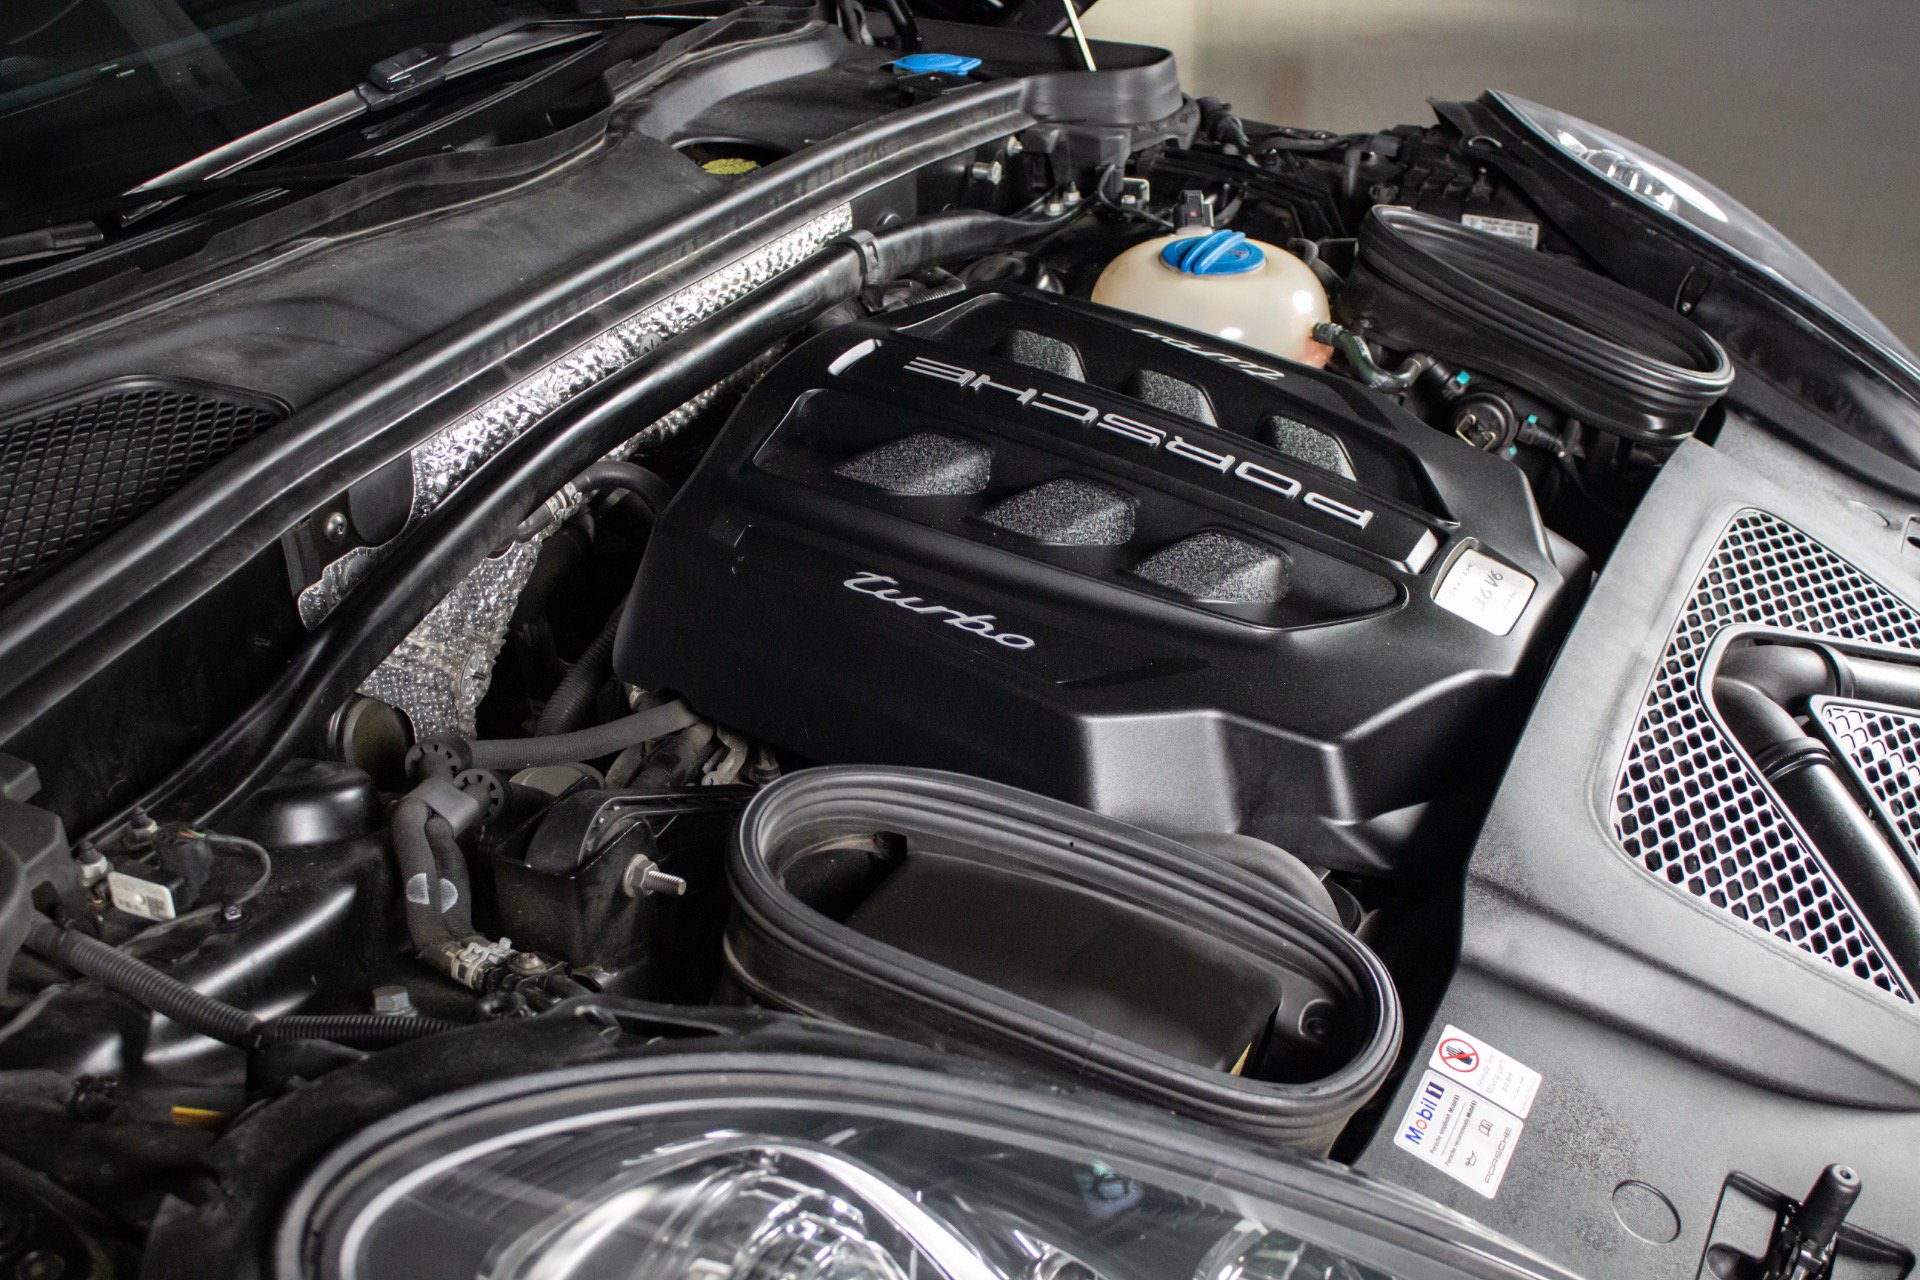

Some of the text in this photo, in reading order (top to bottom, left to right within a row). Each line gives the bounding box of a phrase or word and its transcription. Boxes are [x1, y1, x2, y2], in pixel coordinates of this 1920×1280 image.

[903, 356, 1374, 529] PORSCHE
[1484, 569, 1504, 587] V6
[843, 571, 1036, 650] turbo
[1404, 1081, 1445, 1145] Mobil 1
[1484, 1126, 1512, 1184] PORSCHE
